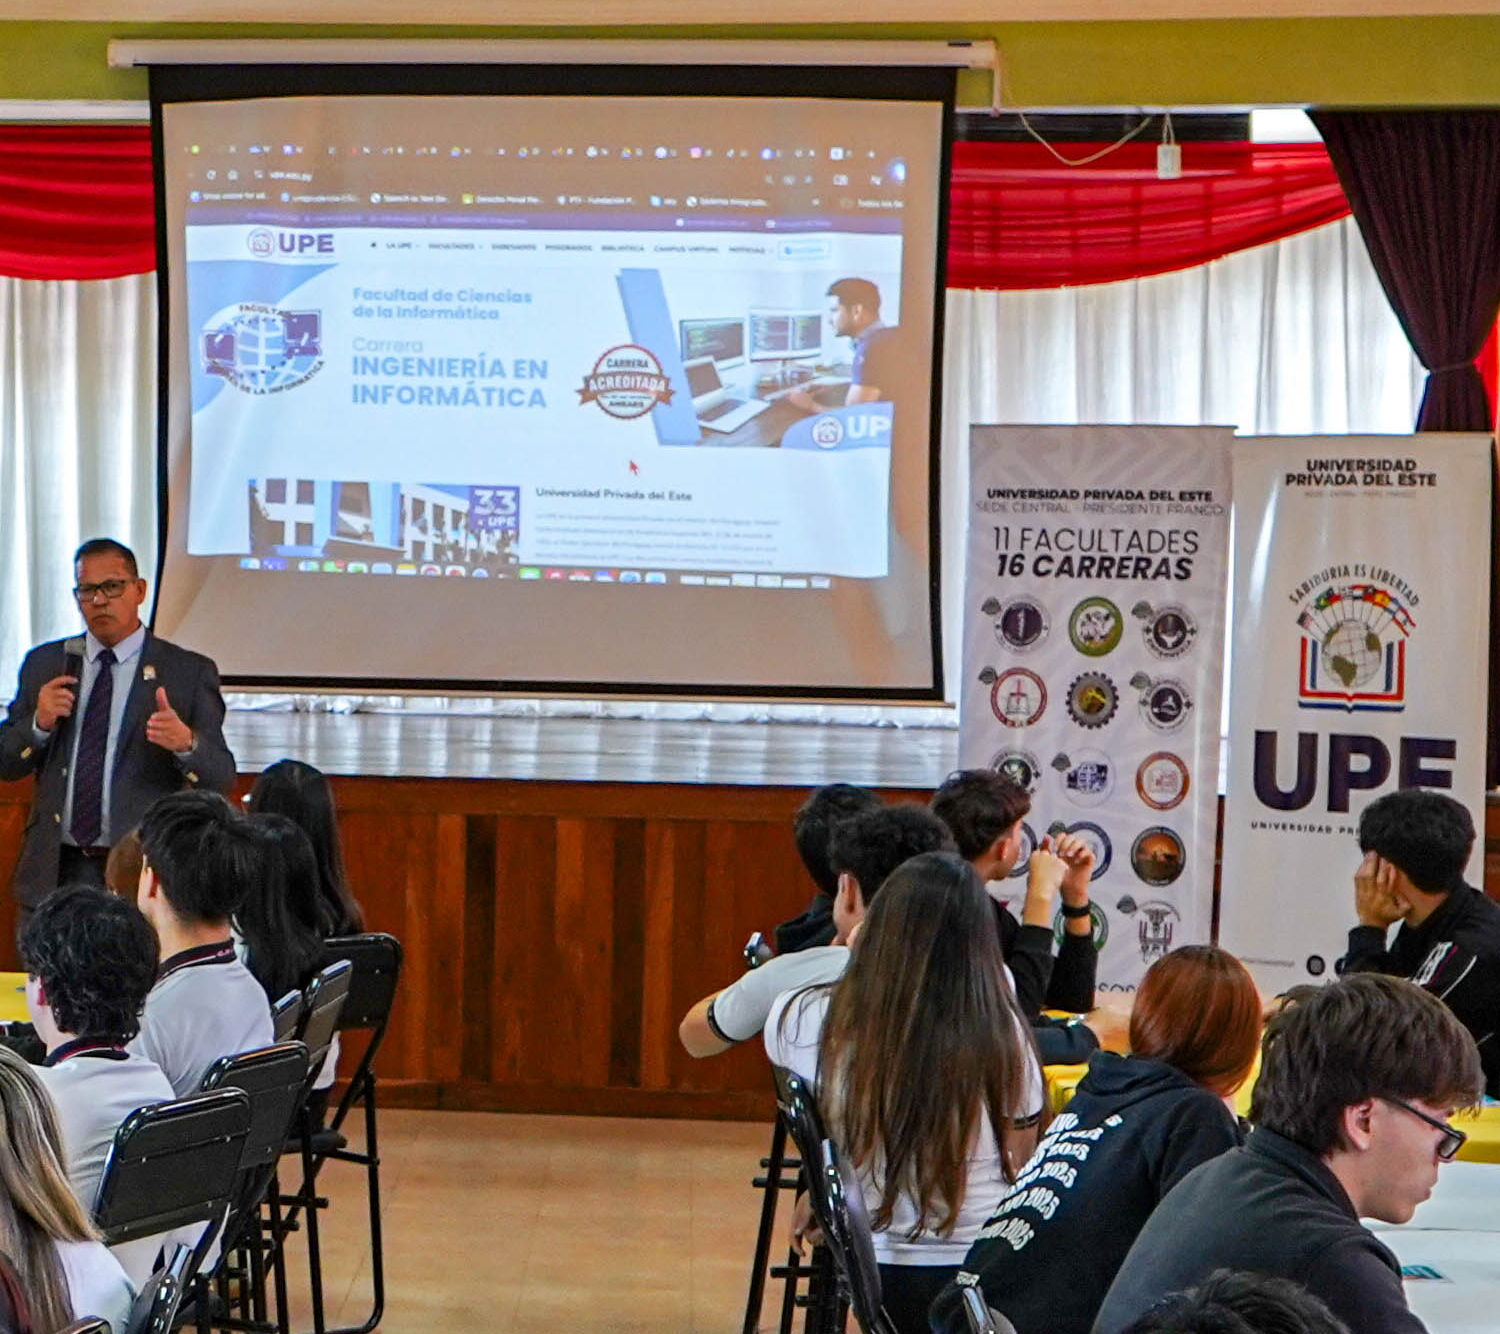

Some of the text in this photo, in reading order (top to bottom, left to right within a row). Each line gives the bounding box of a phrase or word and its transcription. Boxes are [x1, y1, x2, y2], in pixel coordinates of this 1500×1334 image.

[278, 233, 335, 254] UPE
[353, 287, 533, 304] Facultad de Ciencias
[353, 305, 500, 320] de la Informática
[352, 337, 424, 353] Carrera
[352, 352, 548, 379] INGENIERÍA EN
[606, 358, 648, 369] CARRERA
[588, 375, 666, 393] ACREDITADA
[352, 381, 547, 408] INFORMÁTICA
[1305, 458, 1417, 472] UNIVERSIDAD
[1285, 473, 1437, 487] PRIVADA DEL ESTE
[474, 490, 516, 515] 33
[535, 486, 693, 502] Universidad Privada del Este
[987, 488, 1213, 502] UNIVERSIDAD PRIVADA DEL ESTE
[976, 501, 1224, 516] SEDE CENTRAL PRESIDENTE FRANCO
[993, 526, 1200, 555] 11 FACULTADES
[997, 553, 1194, 581] 16 CARRERAS
[1369, 566, 1420, 608] LIBERTAD
[1252, 729, 1457, 814] UPE
[1250, 820, 1333, 835] UNIVERSIDAD
[1023, 1186, 1060, 1220] 2025
